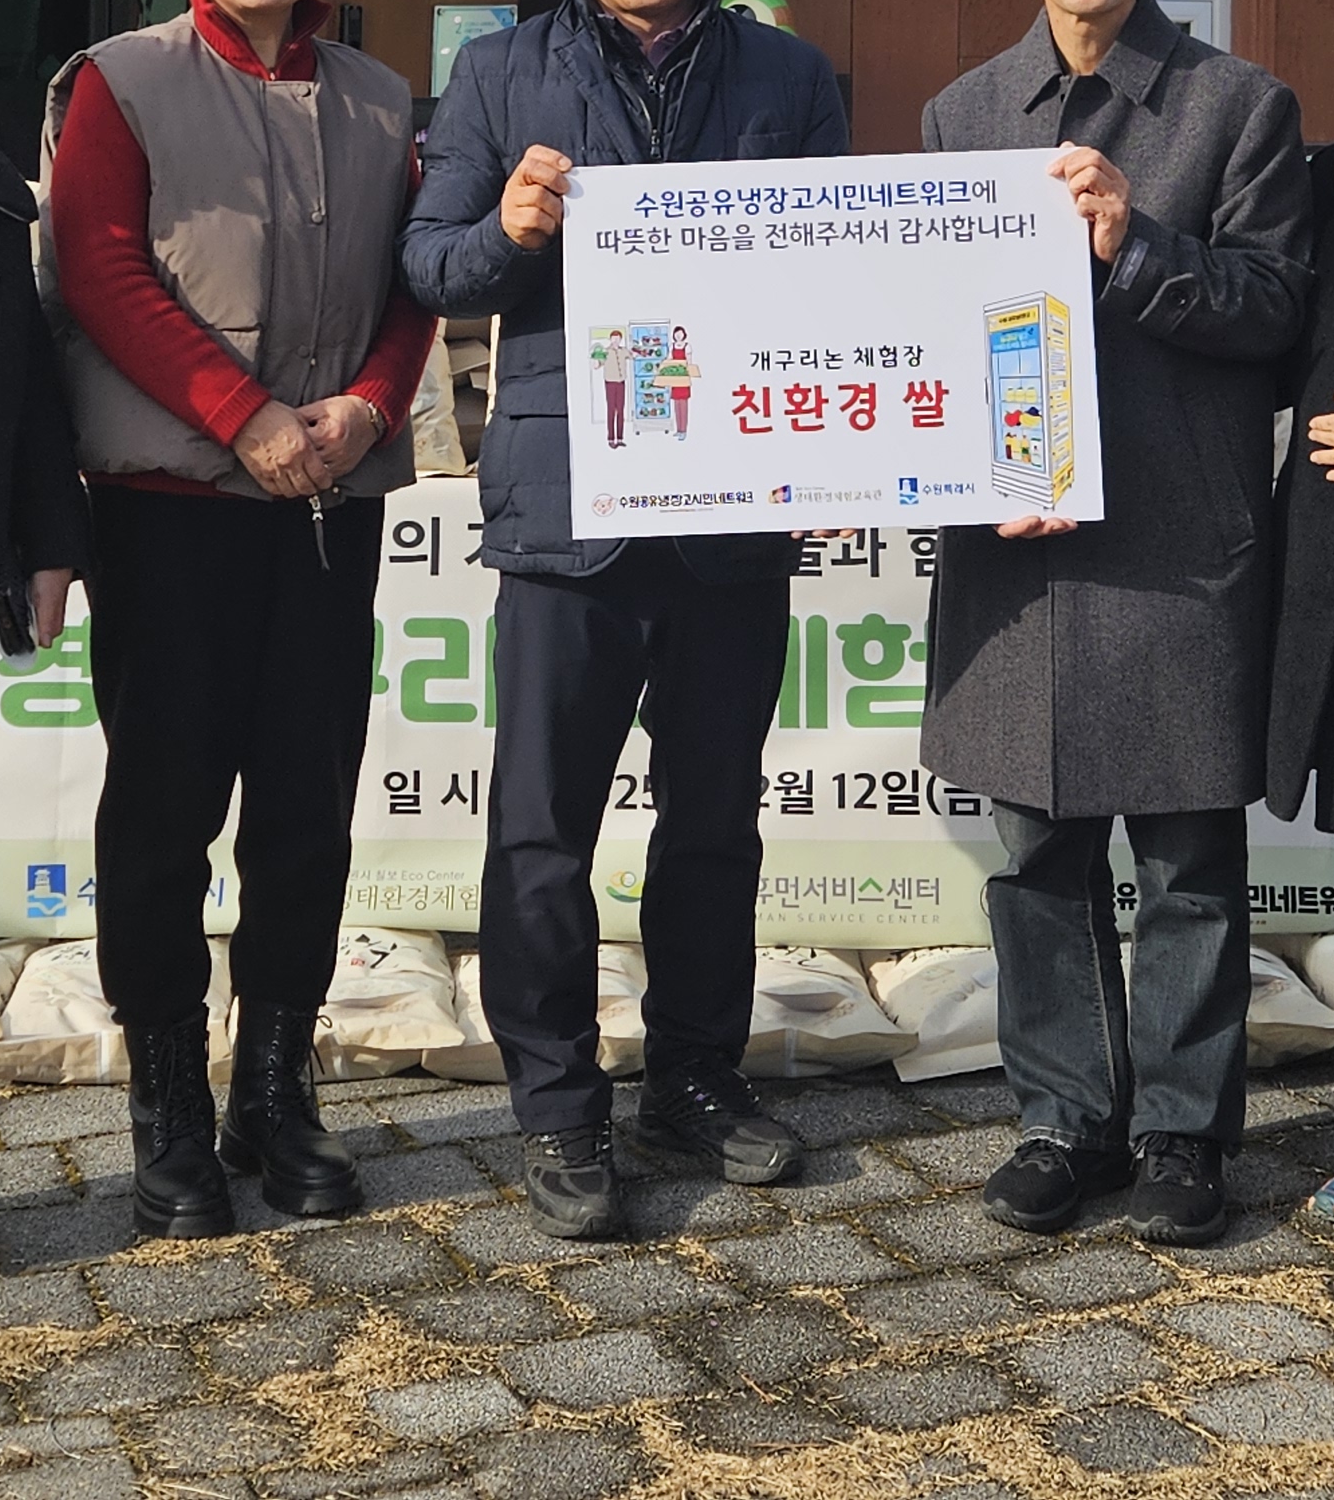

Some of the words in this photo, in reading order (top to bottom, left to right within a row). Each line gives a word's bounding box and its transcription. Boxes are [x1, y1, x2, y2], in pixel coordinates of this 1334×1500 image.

[634, 179, 997, 218] 수원공유냉장고시민네트워크에
[596, 227, 672, 255] 따뜻한
[681, 223, 756, 252] 마음을
[764, 219, 890, 249] 전해주셔서
[899, 212, 1037, 245] 감사합니다!
[749, 347, 845, 371] 개구리논
[852, 344, 925, 368] 체험장
[731, 381, 878, 435] 친환경
[902, 379, 951, 428] 쌀
[401, 870, 424, 881] Eco
[427, 870, 465, 881] Center
[798, 913, 865, 923] SERVICE
[876, 913, 941, 924] CENTER
